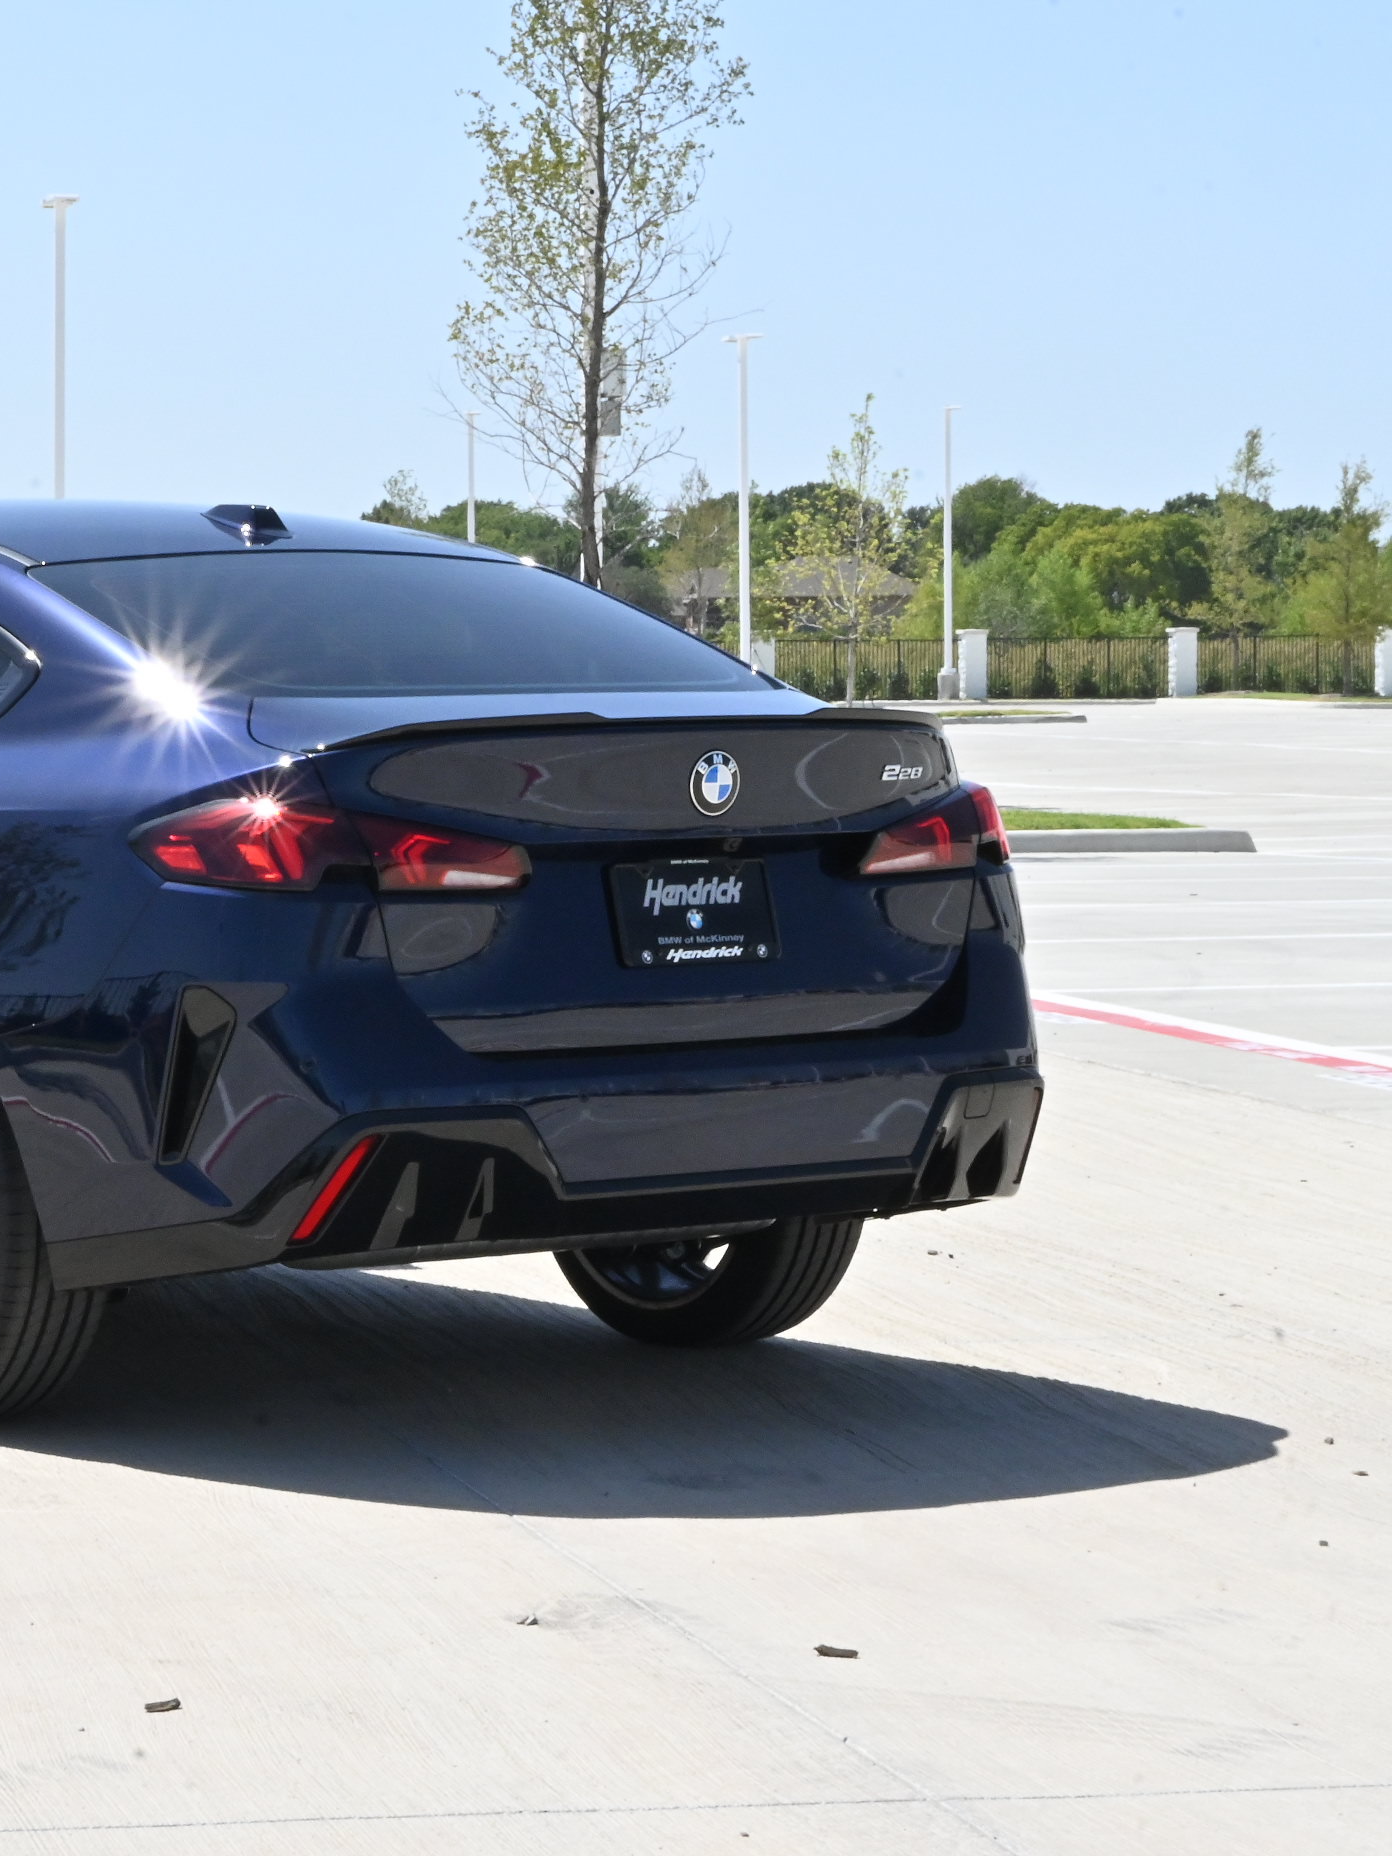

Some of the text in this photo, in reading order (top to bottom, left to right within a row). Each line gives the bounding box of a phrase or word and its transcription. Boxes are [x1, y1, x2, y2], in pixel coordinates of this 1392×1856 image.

[698, 753, 737, 775] BMW
[881, 764, 923, 781] 228
[643, 876, 743, 916] Hendrick
[658, 934, 744, 945] BMW of McKinney
[666, 946, 743, 962] Hendrick
